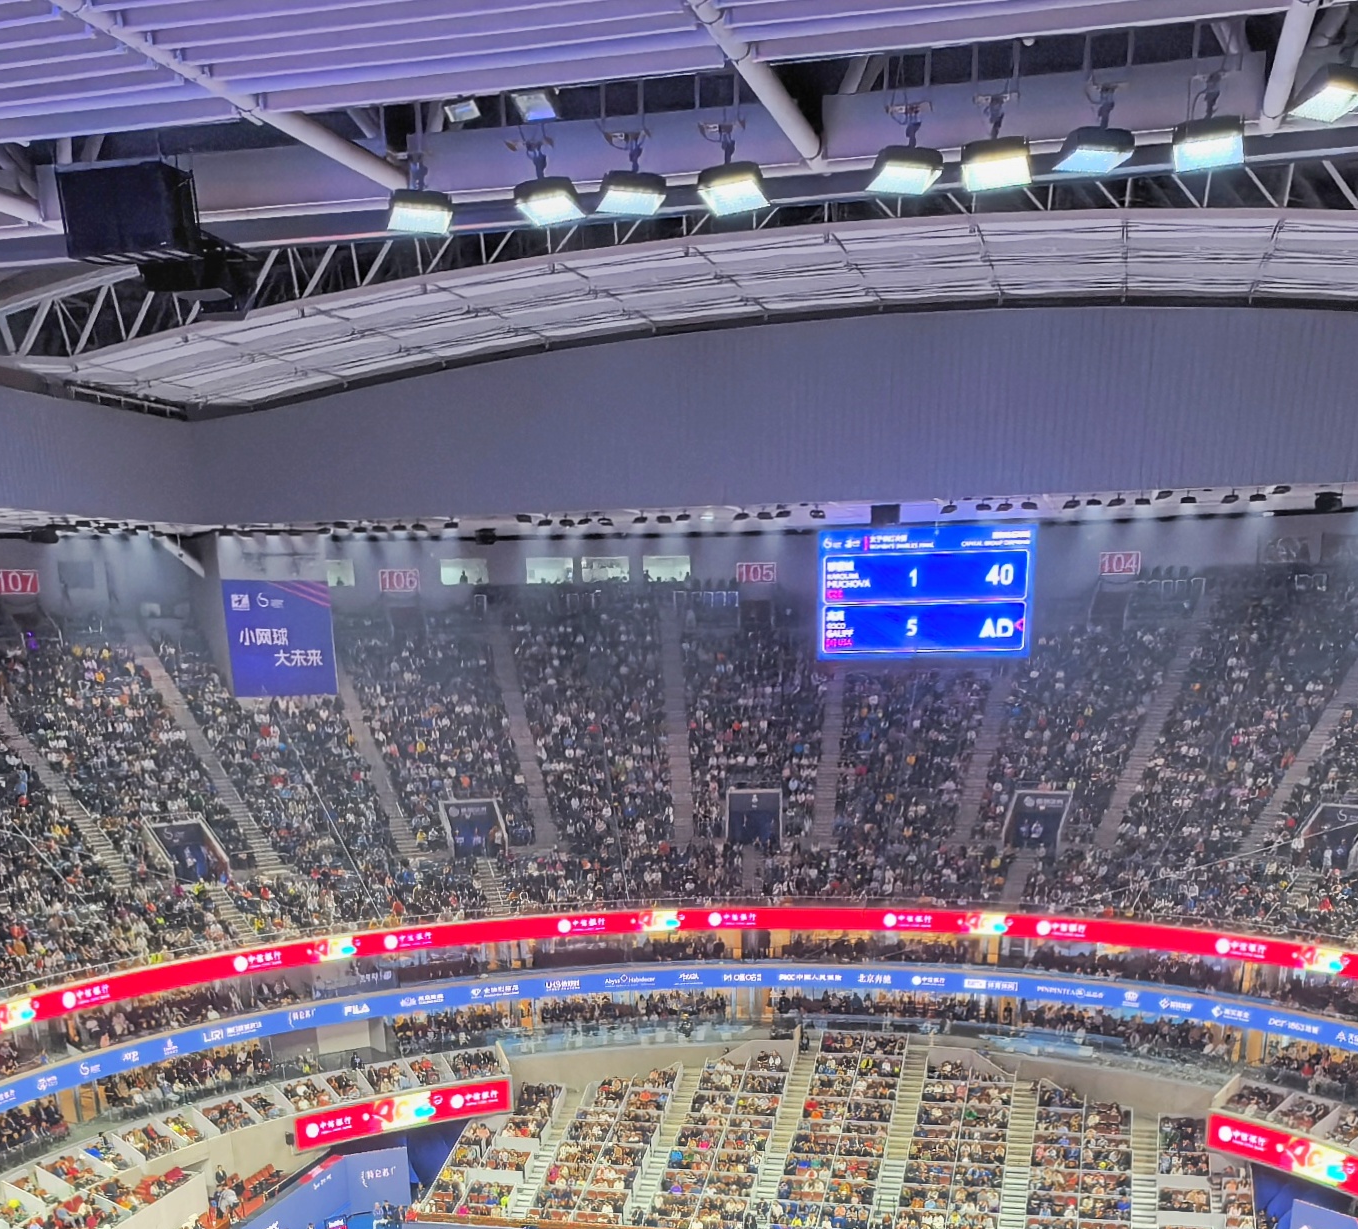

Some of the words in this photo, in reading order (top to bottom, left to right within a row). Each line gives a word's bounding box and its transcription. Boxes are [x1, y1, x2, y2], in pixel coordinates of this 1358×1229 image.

[740, 563, 775, 583] 105
[1101, 555, 1138, 574] 104
[381, 571, 417, 591] 106
[909, 567, 918, 587] 1
[985, 563, 1014, 585] 40
[239, 627, 289, 646] 小网球
[906, 617, 918, 637] 5
[978, 617, 1014, 638] AD
[274, 649, 323, 667] 大未来
[344, 1003, 370, 1016] FILA
